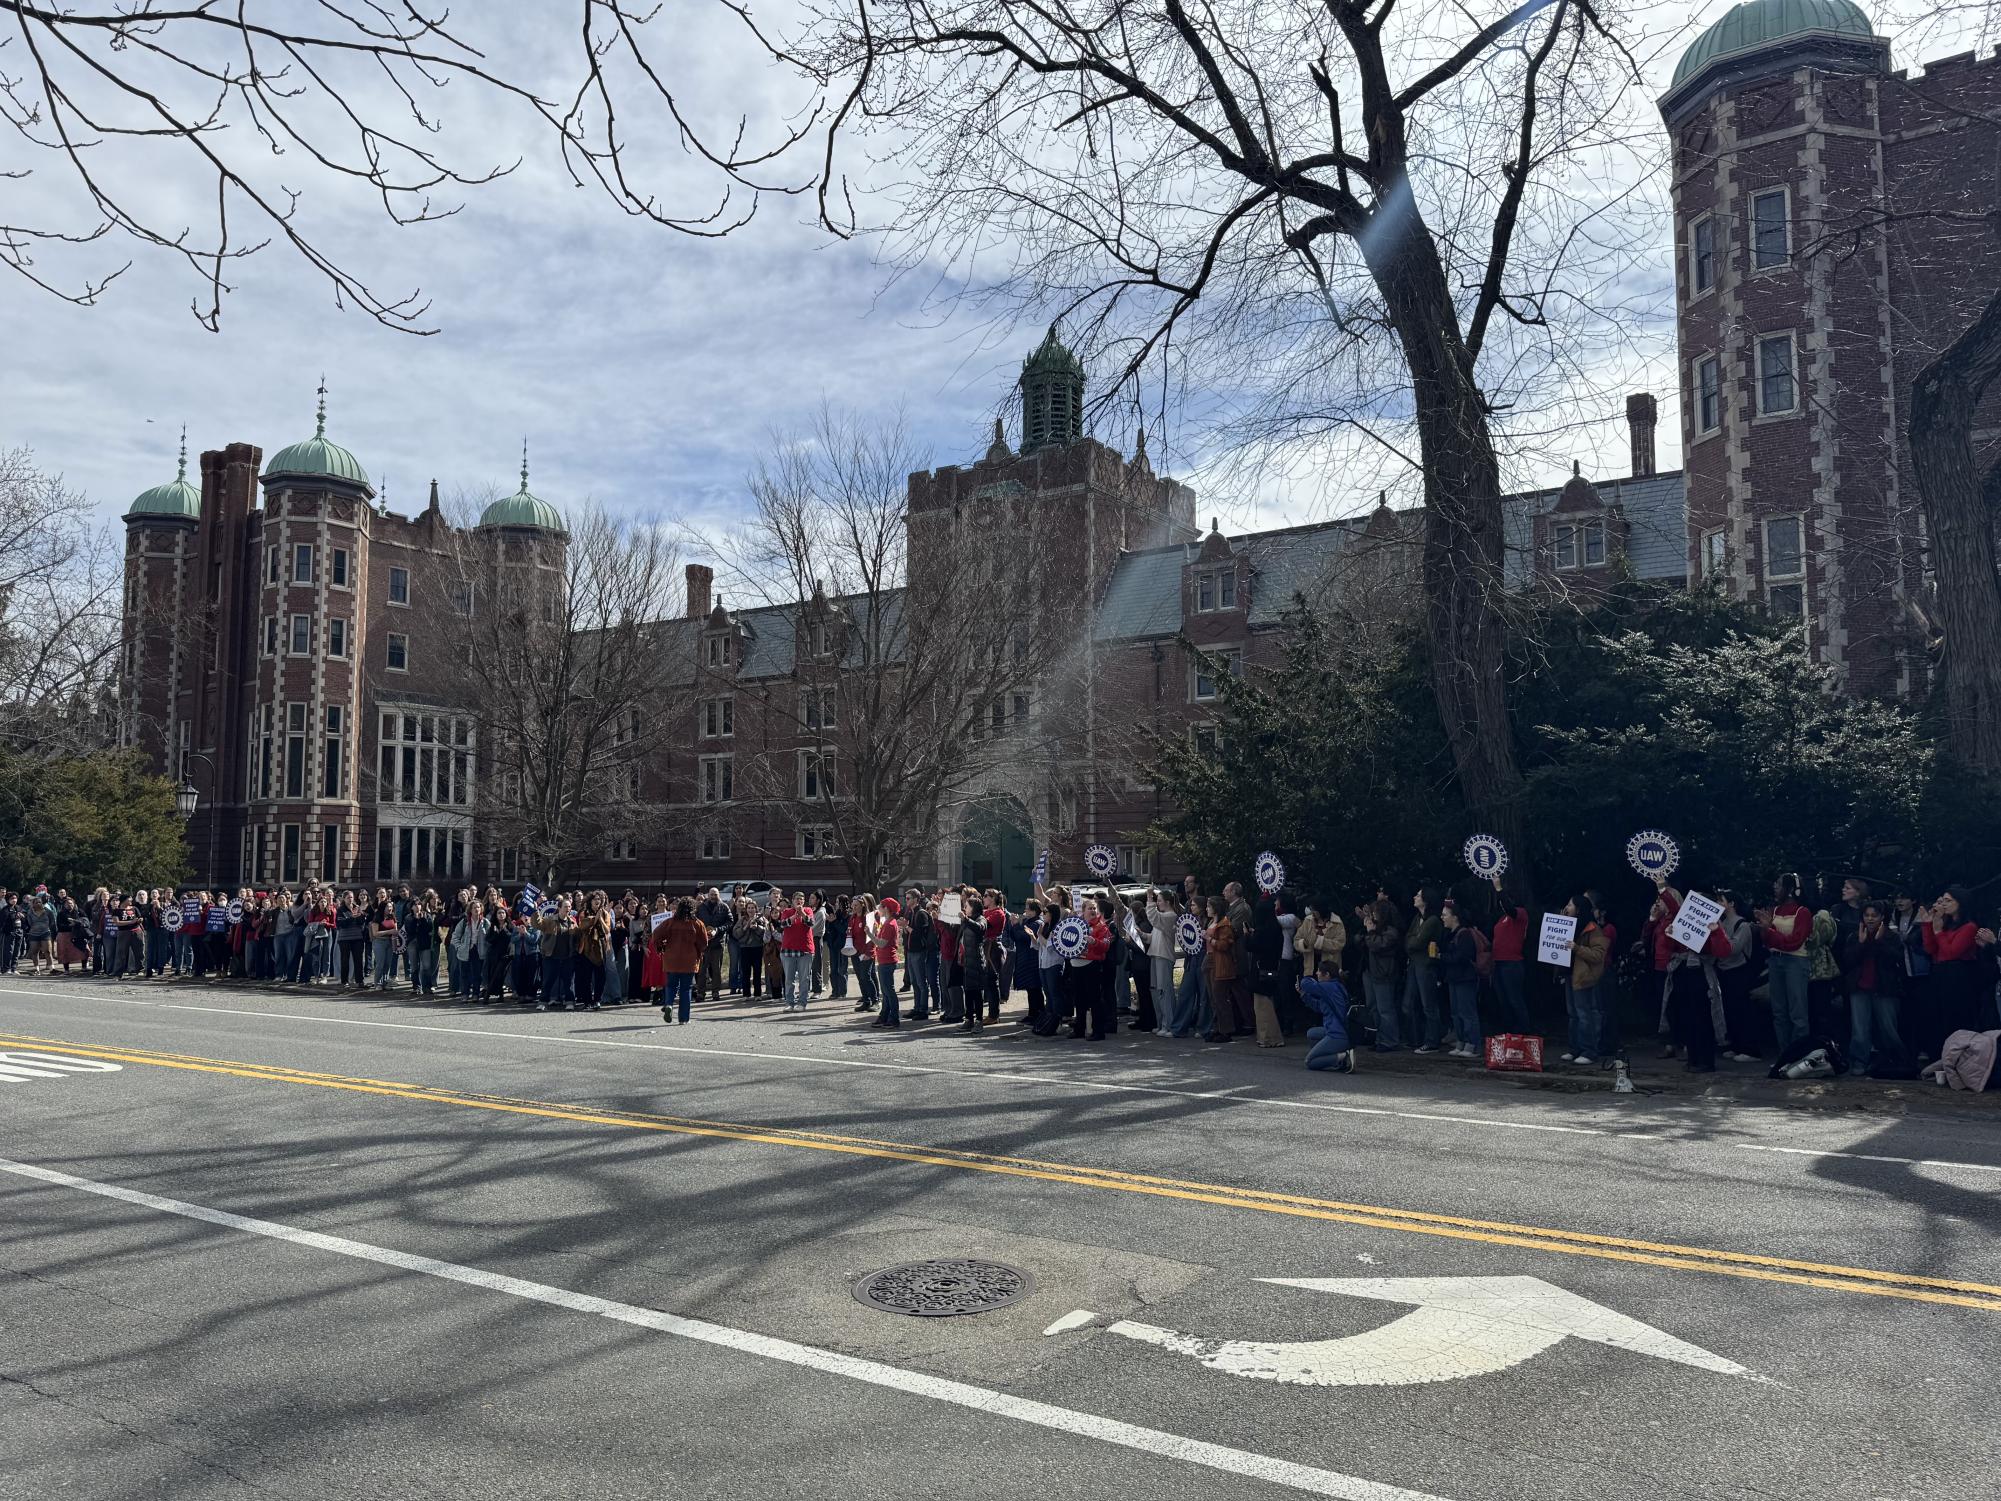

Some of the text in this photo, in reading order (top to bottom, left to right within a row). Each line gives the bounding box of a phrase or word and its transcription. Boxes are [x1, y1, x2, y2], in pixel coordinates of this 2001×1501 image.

[1093, 855, 1107, 868] UAW
[1480, 847, 1490, 868] UAW
[1640, 849, 1664, 862] UAW
[1262, 866, 1274, 880] UAW
[1689, 906, 1711, 920] FIGHT
[1547, 926, 1568, 935] FIGHT
[1678, 917, 1706, 938] FUTURE
[1062, 930, 1078, 943] UAW
